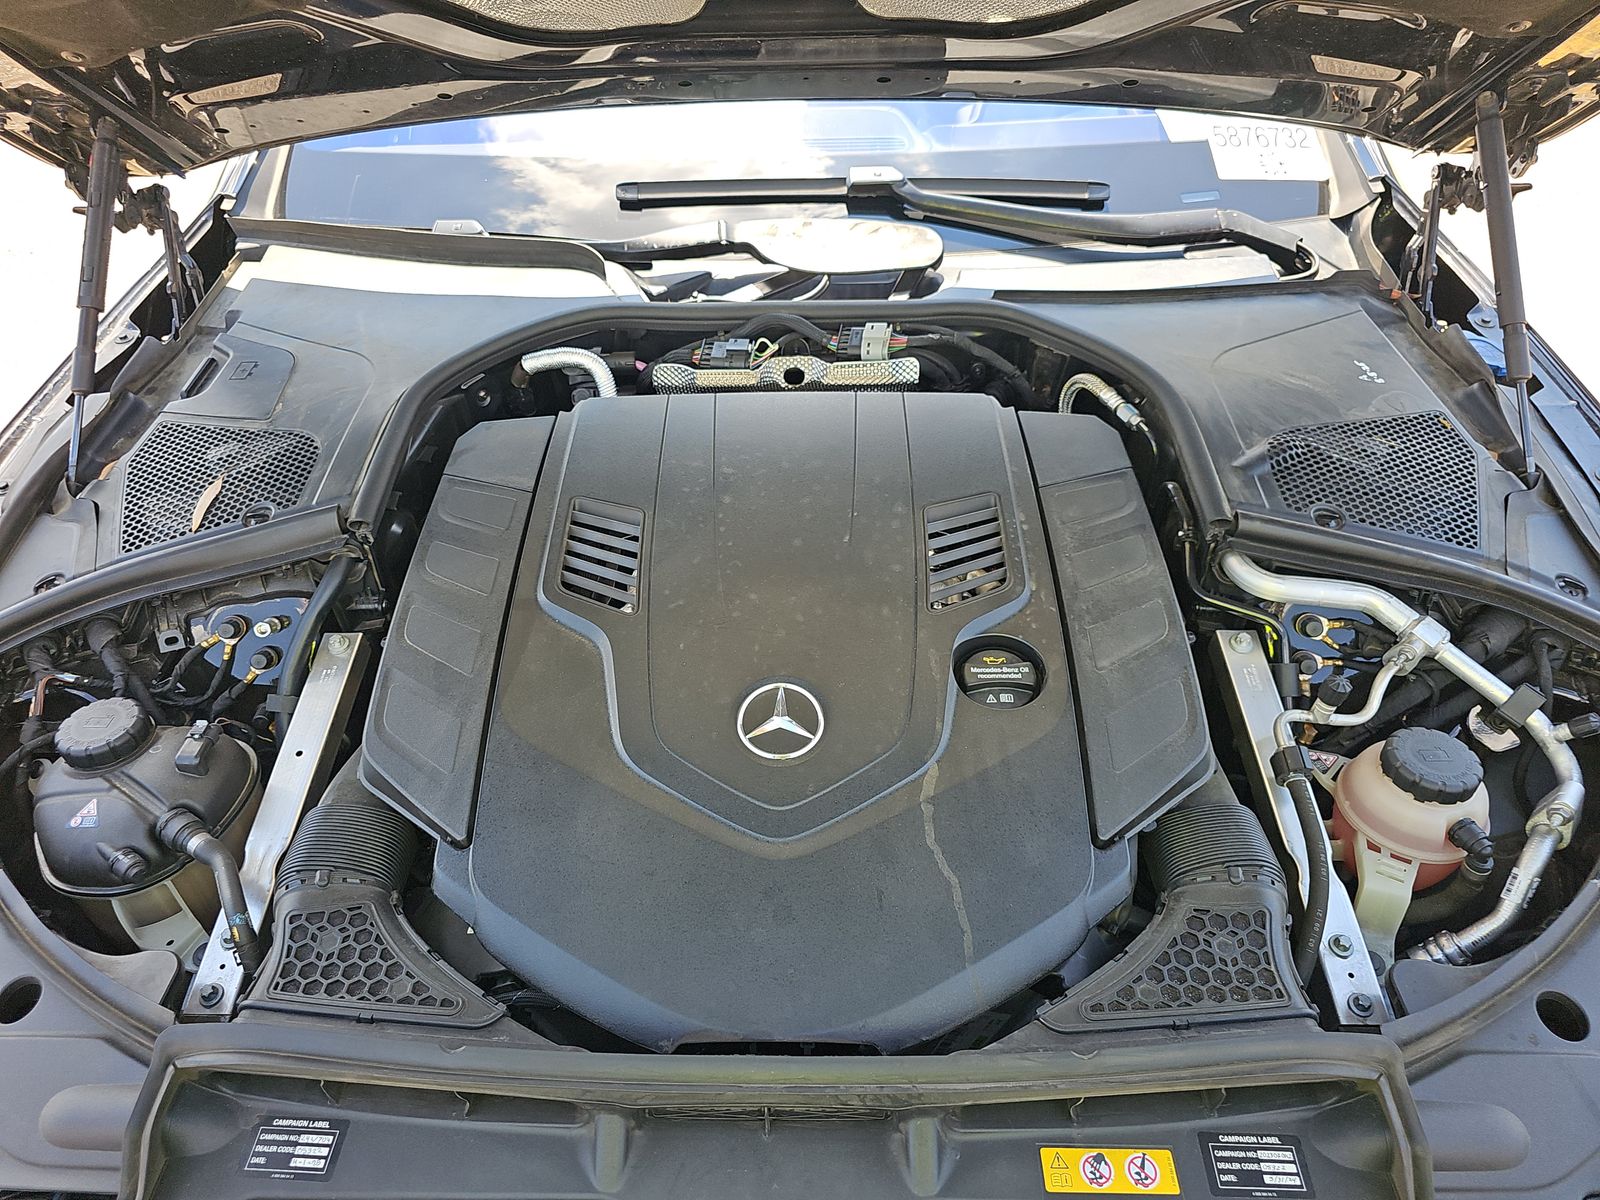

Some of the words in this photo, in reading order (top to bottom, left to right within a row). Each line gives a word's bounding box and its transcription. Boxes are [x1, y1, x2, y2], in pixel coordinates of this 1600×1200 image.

[1213, 125, 1312, 148] 5876732
[273, 1118, 308, 1127] CAMPAIGN
[309, 1120, 330, 1128] LABEL
[259, 1133, 289, 1141] CAMPAIGN
[1219, 1135, 1258, 1143] CAMPAIGN
[1258, 1136, 1282, 1144] LABEL
[255, 1145, 277, 1153] DEALER
[277, 1146, 295, 1154] CODE:
[1214, 1150, 1246, 1158] CAMPAIGN
[250, 1156, 268, 1164] DATE:
[1216, 1162, 1242, 1170] DEALER
[1242, 1162, 1261, 1171] CODE:
[1219, 1174, 1238, 1182] DATE:
